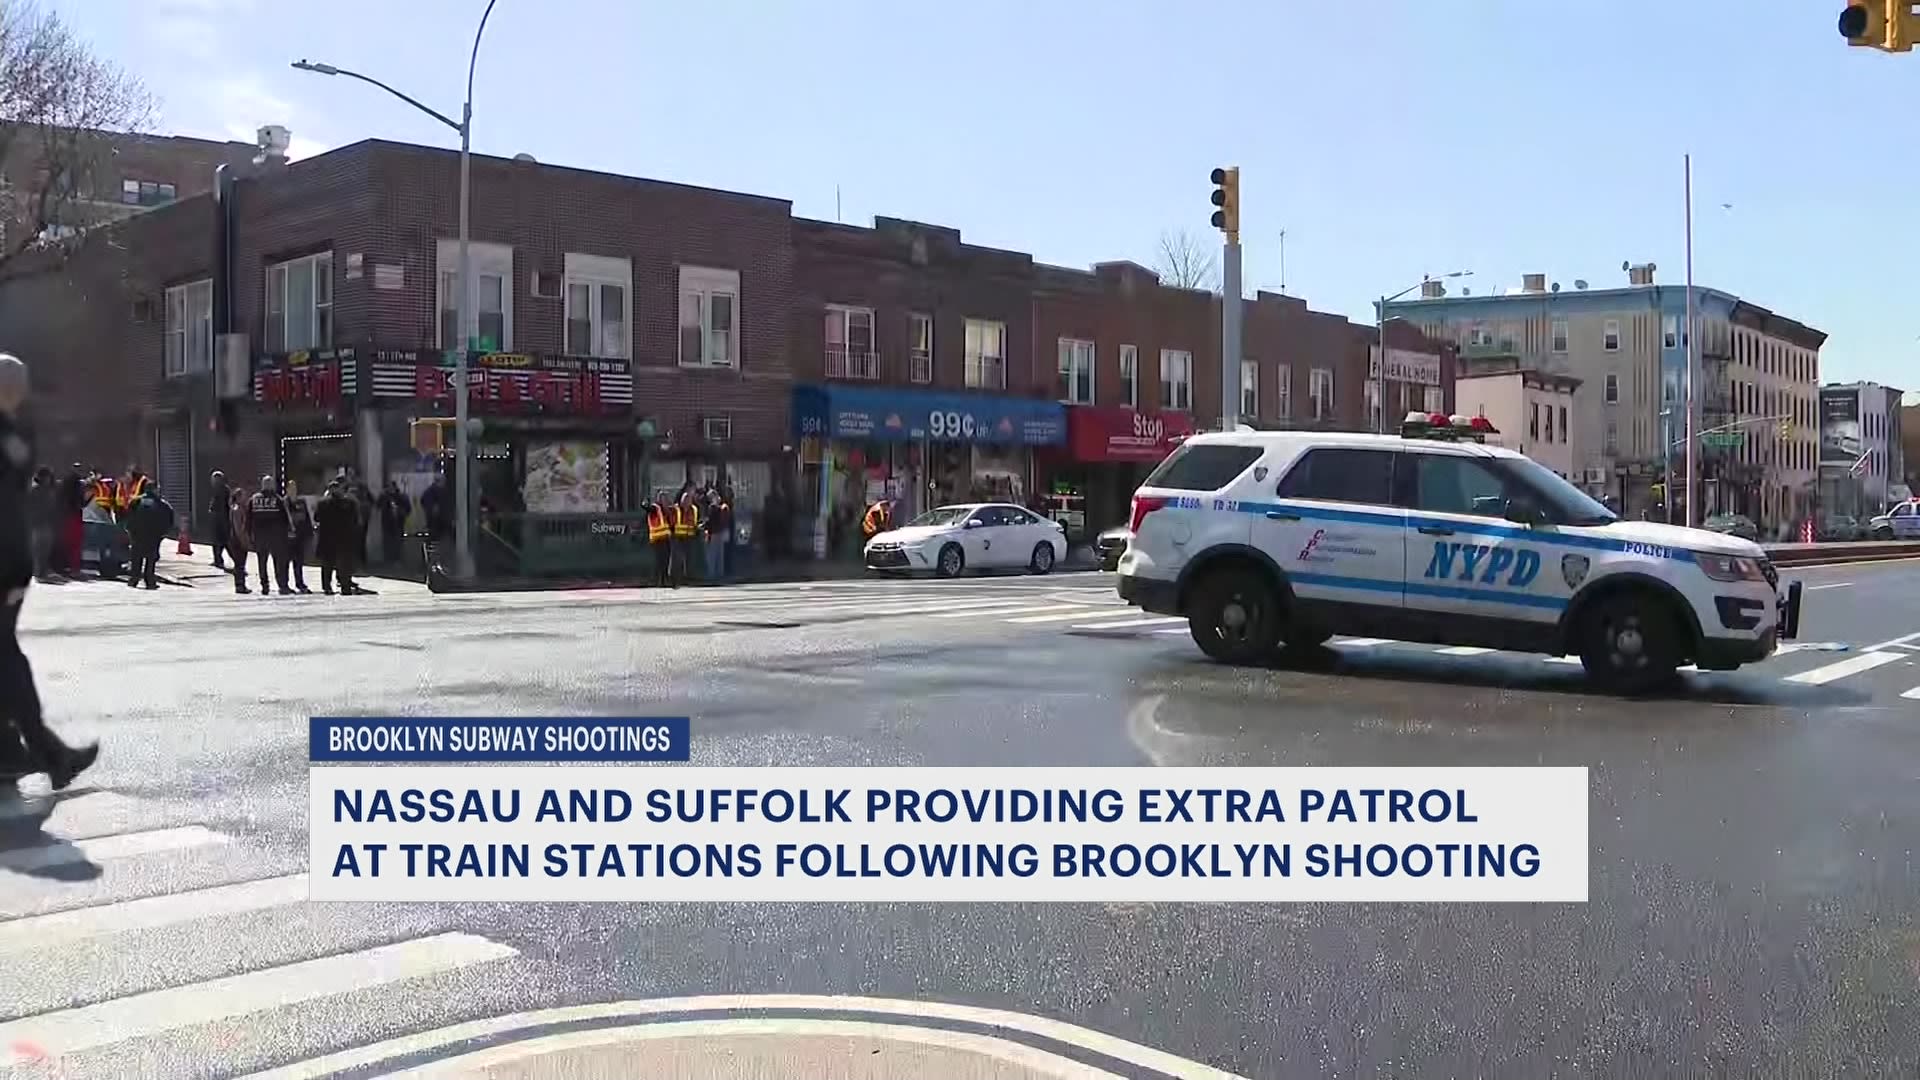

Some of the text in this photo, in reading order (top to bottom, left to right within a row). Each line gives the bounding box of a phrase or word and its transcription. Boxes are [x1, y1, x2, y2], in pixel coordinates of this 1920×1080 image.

[1373, 362, 1411, 379] FNERAL
[929, 410, 975, 438] 99¢
[1133, 413, 1164, 441] Stop
[591, 522, 625, 535] Subway
[1625, 541, 1671, 559] POLICE
[1424, 541, 1541, 587] NYPD
